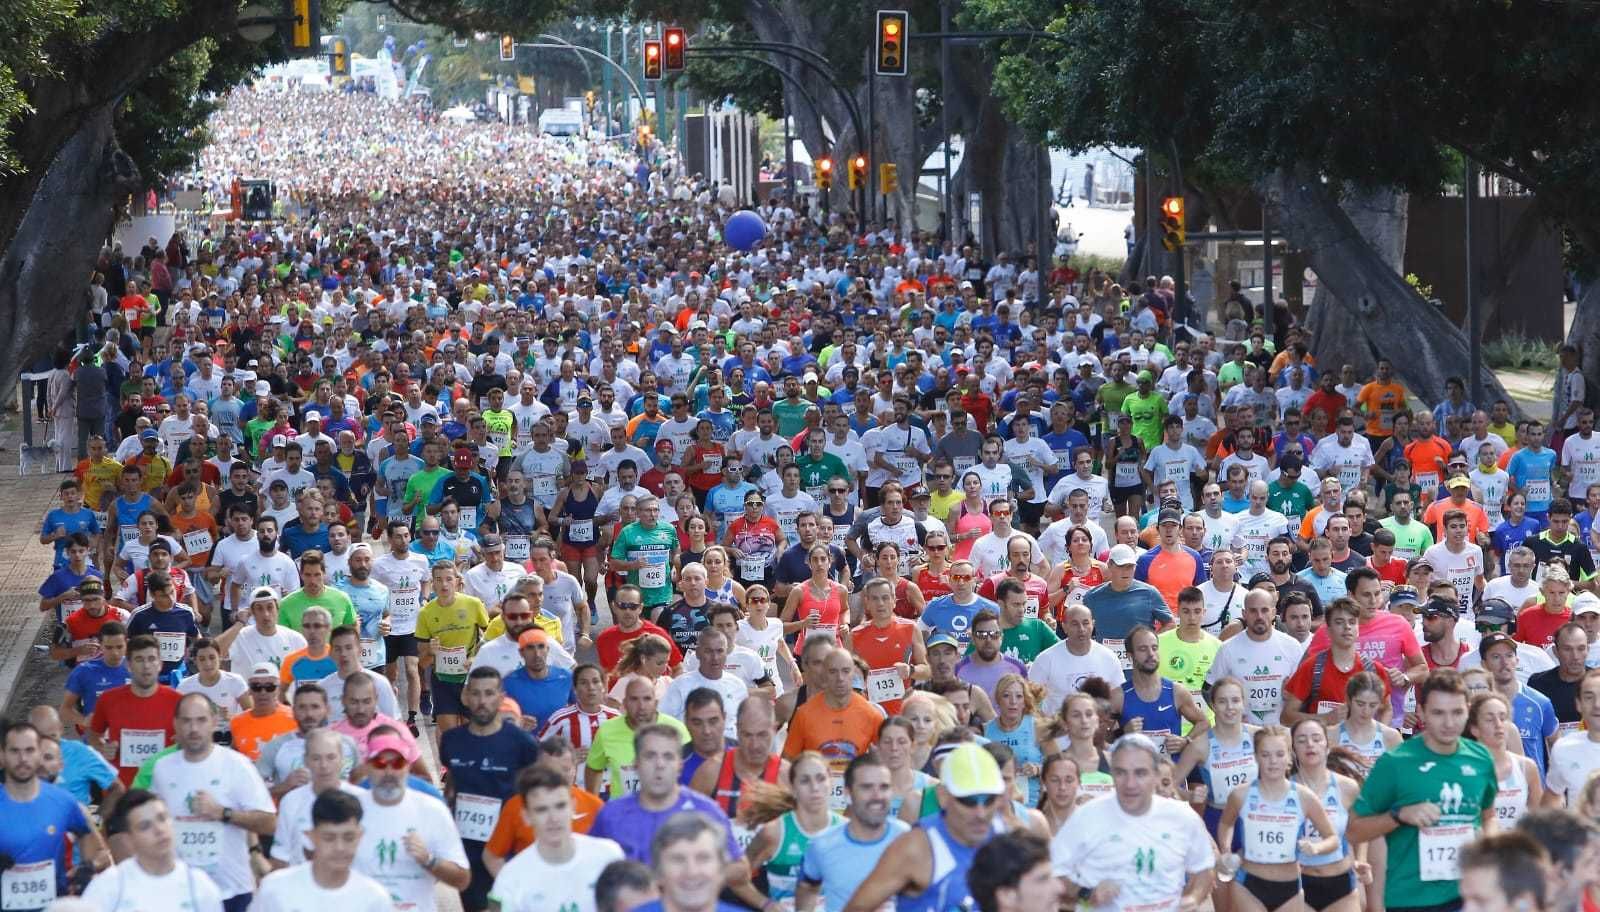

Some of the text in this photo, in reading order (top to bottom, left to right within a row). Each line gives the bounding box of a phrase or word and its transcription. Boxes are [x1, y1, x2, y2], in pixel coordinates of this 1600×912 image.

[1452, 577, 1470, 586] 6522
[395, 597, 414, 606] 6382
[876, 679, 895, 690] 133
[1250, 688, 1277, 698] 2076
[129, 744, 158, 754] 1506
[1224, 773, 1247, 787] 192
[457, 810, 493, 826] 17491
[182, 832, 216, 845] 2305
[1257, 831, 1284, 844] 166
[1426, 847, 1456, 861] 172
[11, 879, 48, 894] 6386
